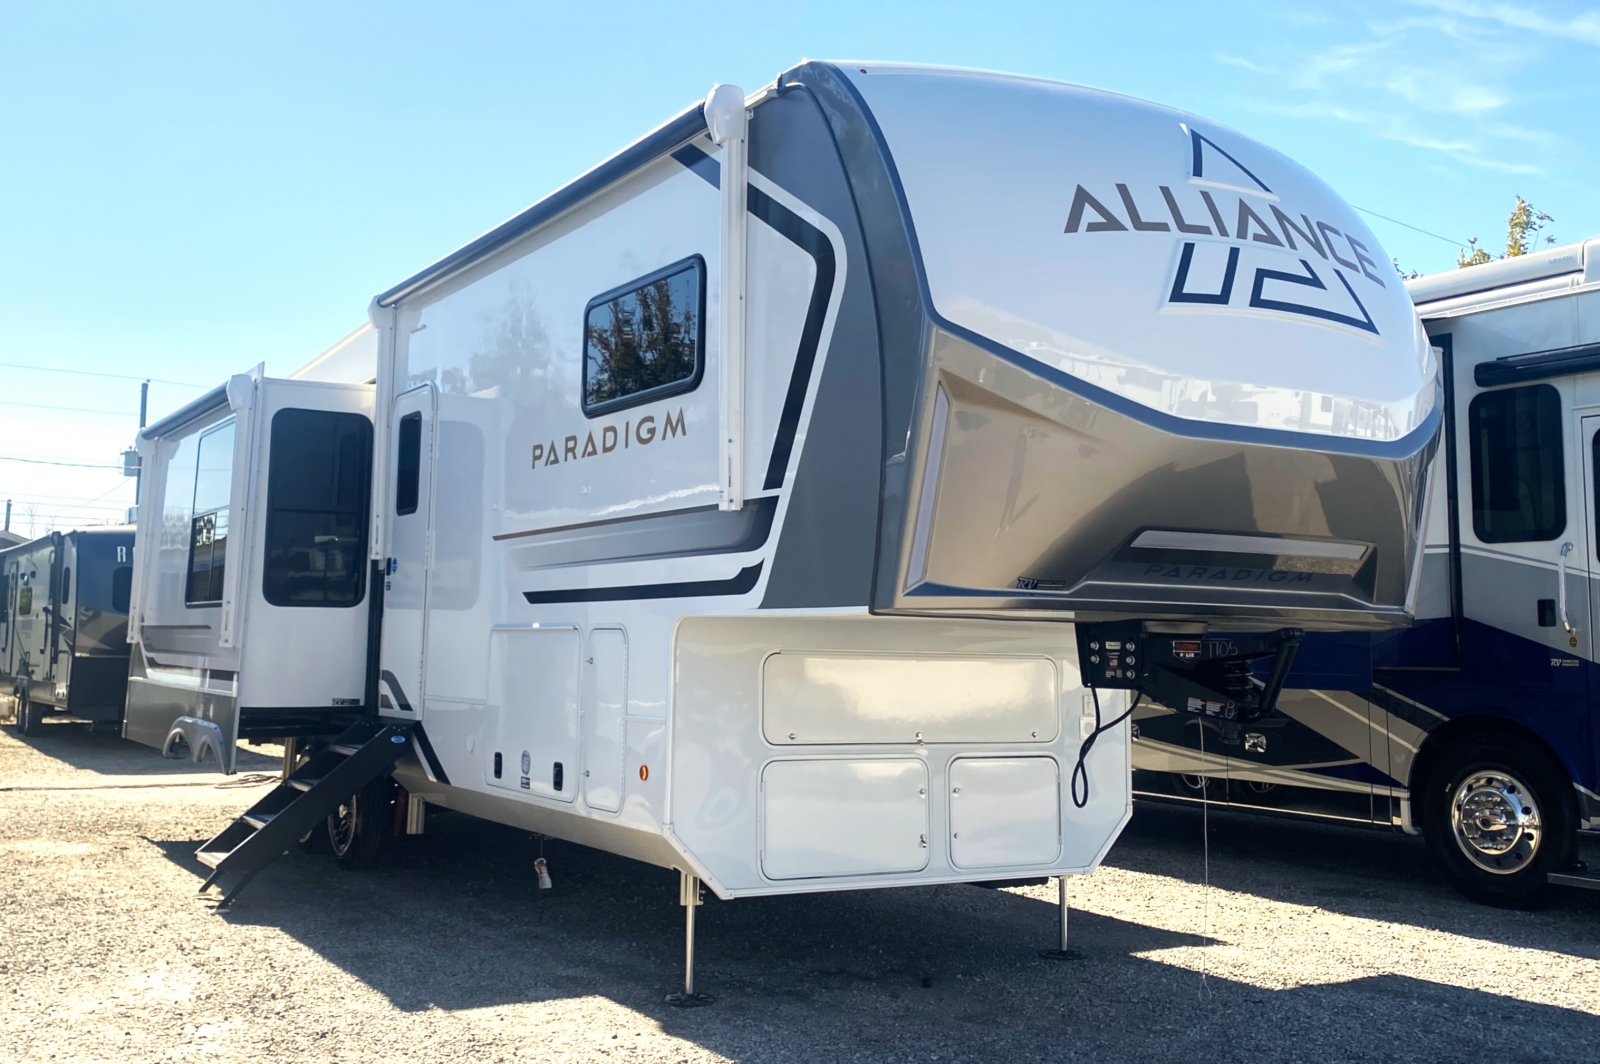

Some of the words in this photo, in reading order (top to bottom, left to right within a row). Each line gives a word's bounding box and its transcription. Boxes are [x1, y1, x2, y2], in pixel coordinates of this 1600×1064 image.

[1063, 183, 1387, 289] ALLIANCE
[531, 406, 687, 470] PARADIGM
[1017, 577, 1038, 589] RV
[1143, 564, 1313, 584] PARADIGM
